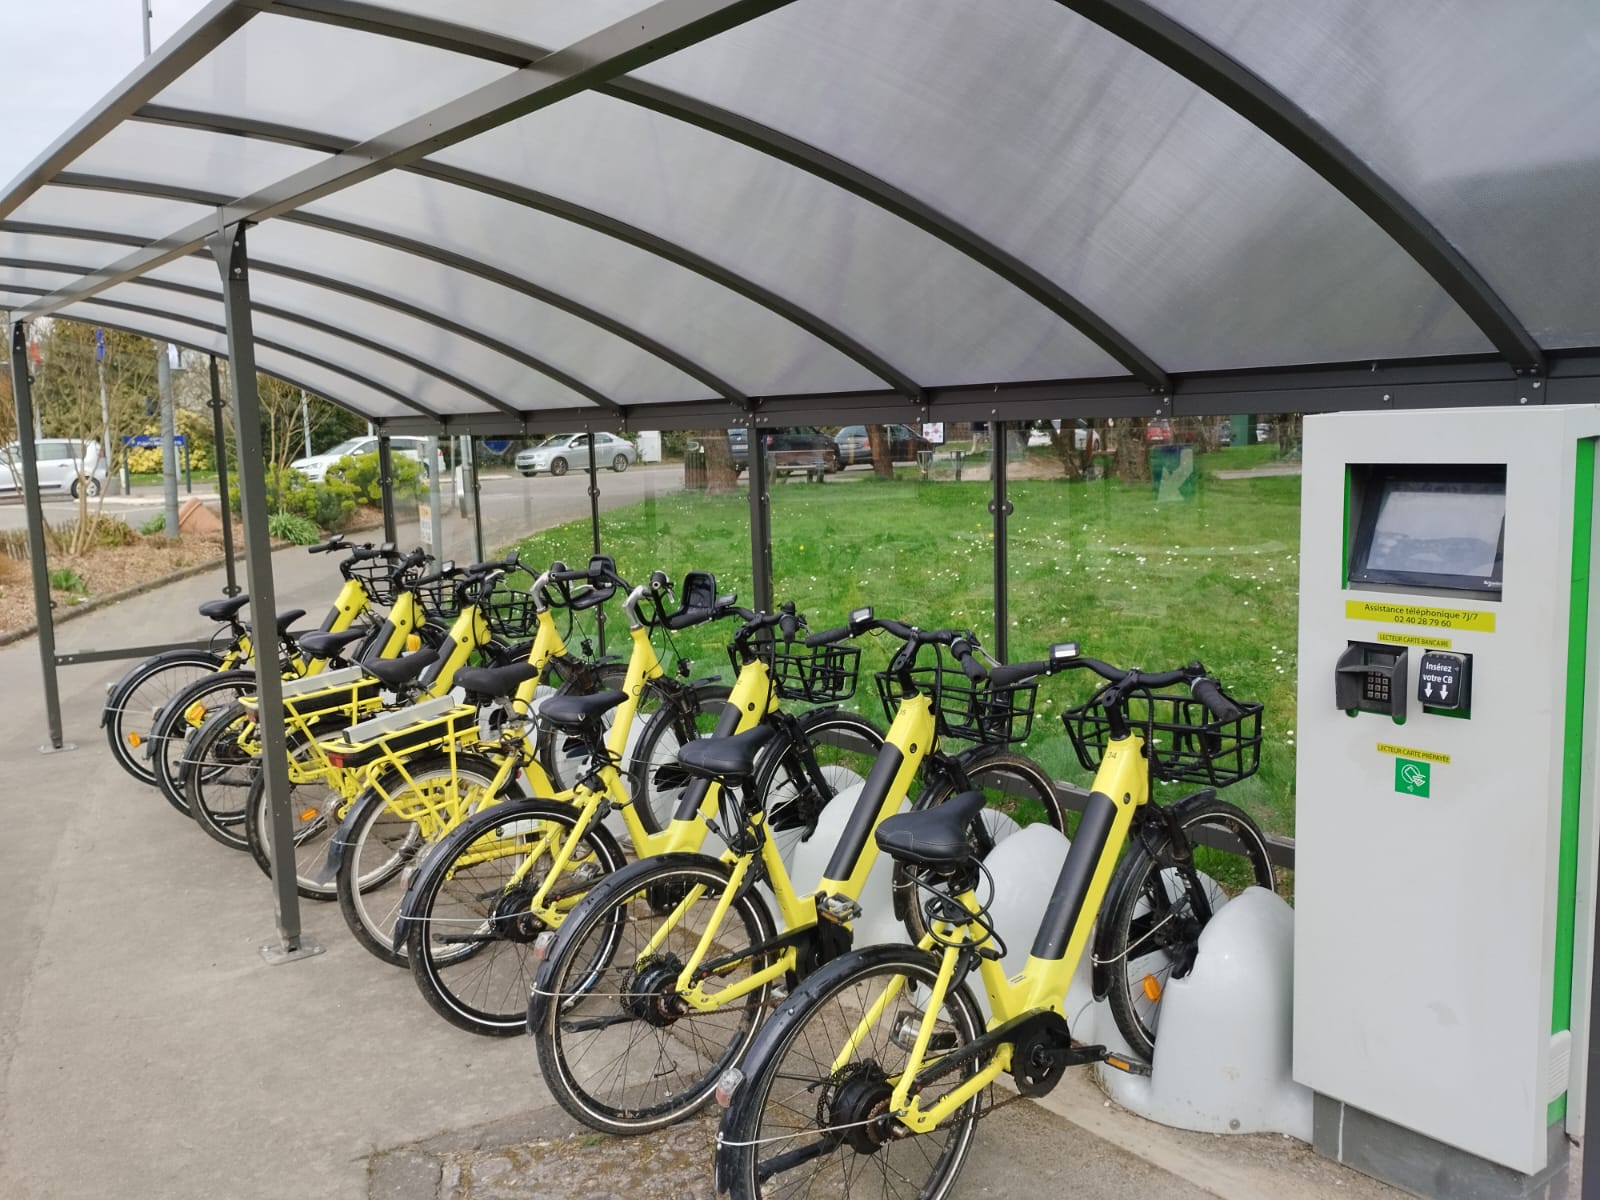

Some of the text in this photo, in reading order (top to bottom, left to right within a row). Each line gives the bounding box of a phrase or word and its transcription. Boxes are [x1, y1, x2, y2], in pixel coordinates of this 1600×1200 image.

[1364, 603, 1404, 613] Assistance
[1405, 607, 1460, 619] téléphonique
[1394, 615, 1404, 623] 02
[1379, 633, 1449, 648] LECTEUR CARTE BANCAIRE
[1425, 661, 1452, 672] Insérez
[1423, 673, 1453, 684] votre CB
[1377, 744, 1402, 755] LECTEUR
[1402, 748, 1421, 758] CARTE
